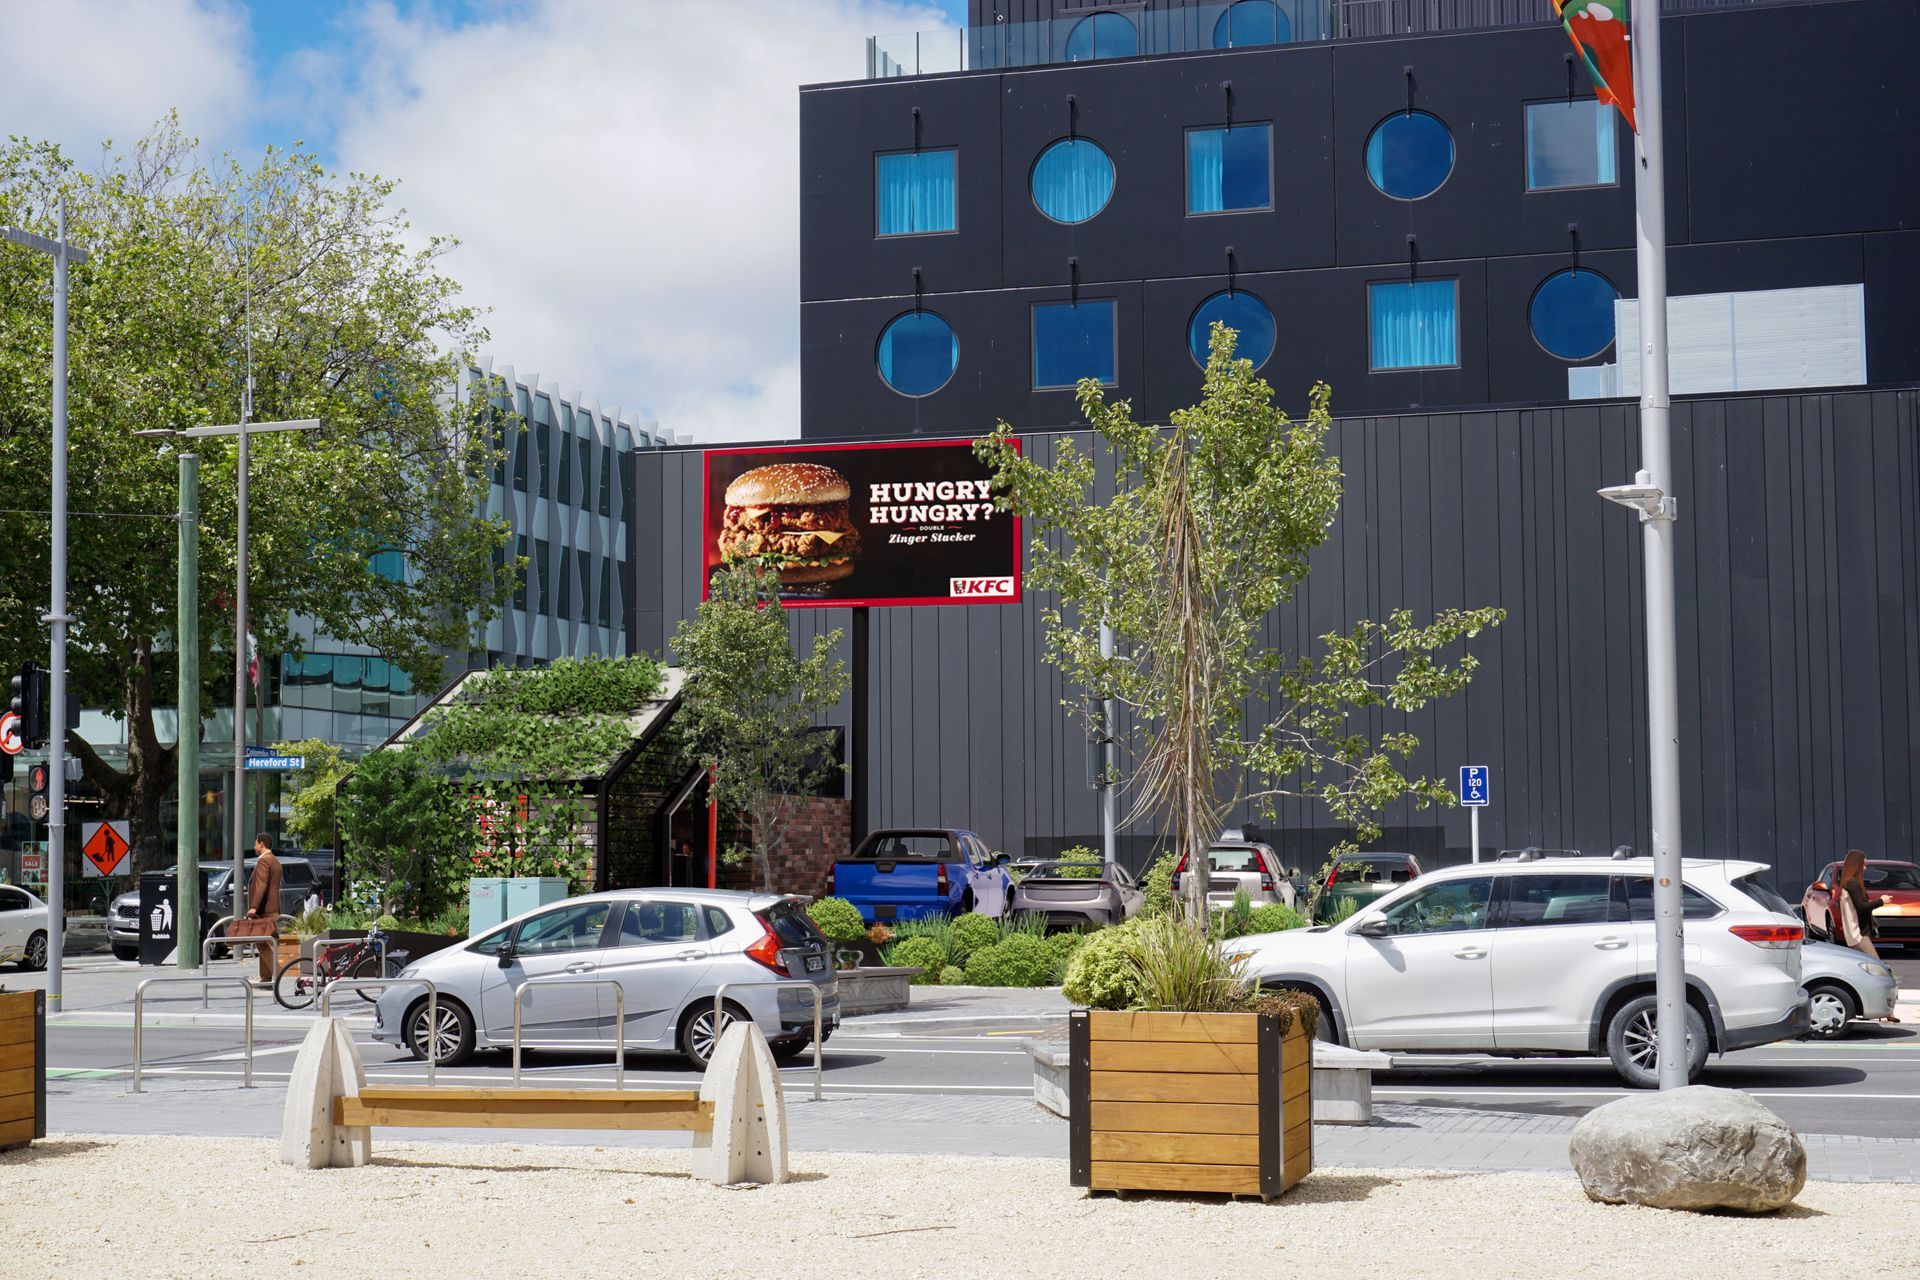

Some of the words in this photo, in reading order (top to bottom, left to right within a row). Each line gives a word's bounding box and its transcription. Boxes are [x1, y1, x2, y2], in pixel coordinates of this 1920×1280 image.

[869, 480, 993, 503] HUNGRY
[869, 503, 995, 523] HUNGRY?
[888, 533, 928, 545] Zinger
[930, 532, 976, 543] Stacker
[967, 579, 1009, 594] KFC
[248, 757, 288, 767] Hereford
[289, 757, 300, 767] St
[1469, 768, 1479, 778] P
[1468, 778, 1482, 787] 120
